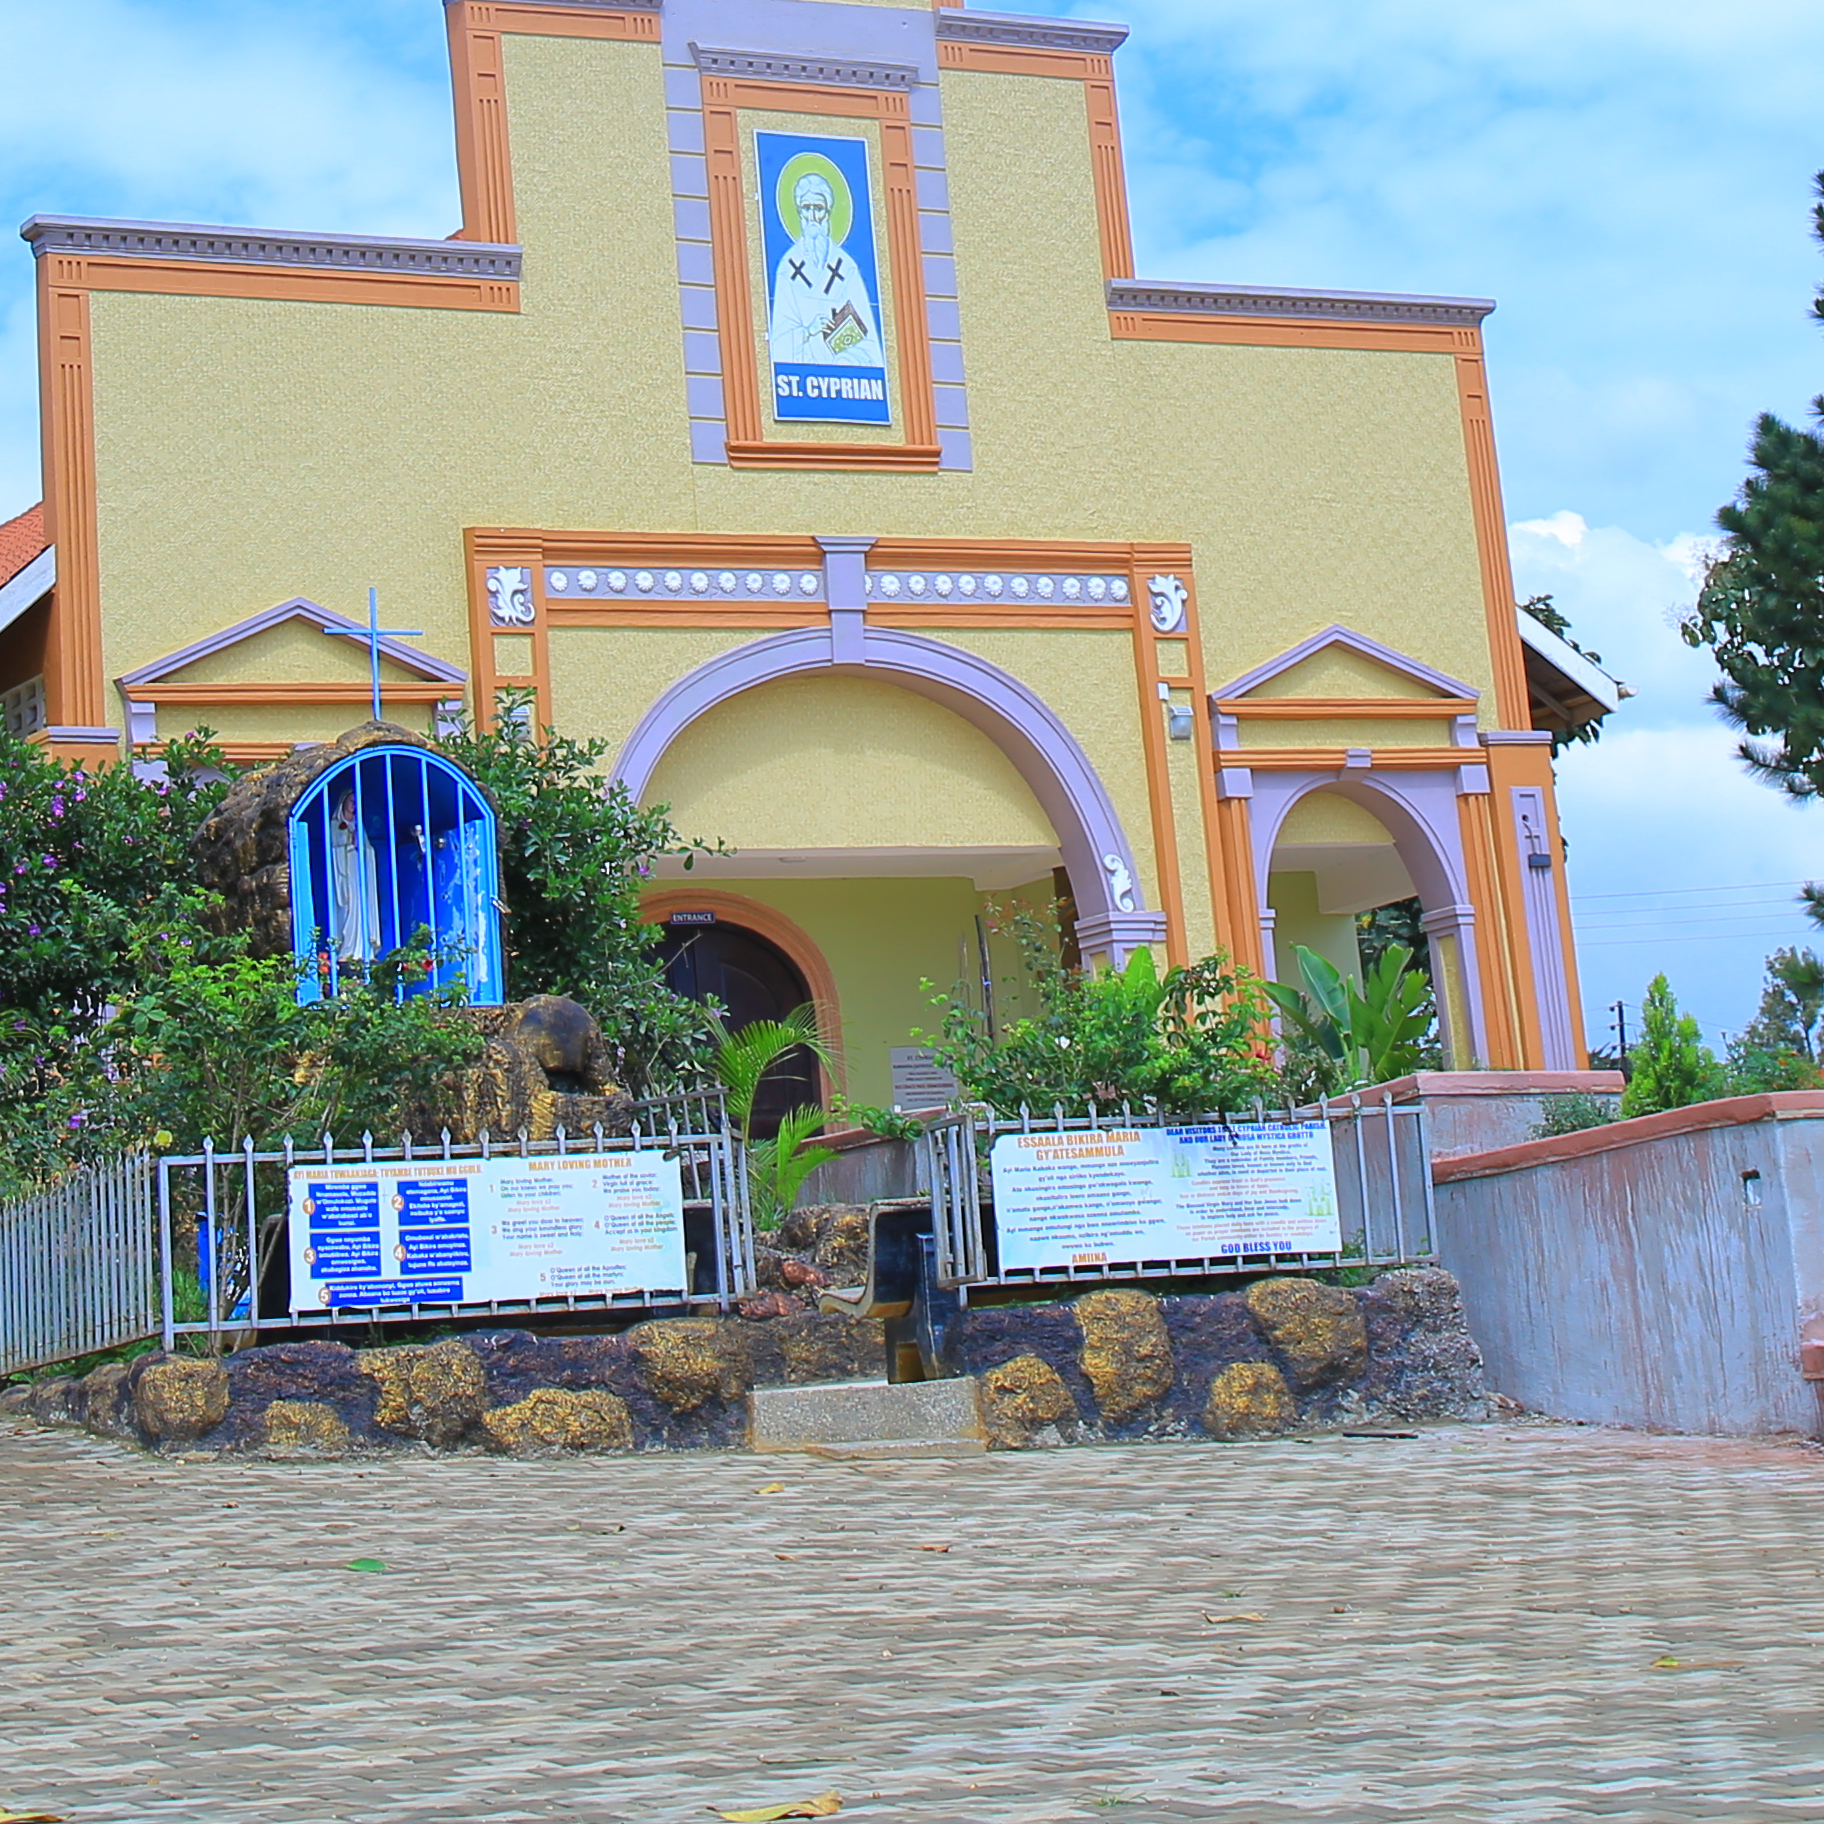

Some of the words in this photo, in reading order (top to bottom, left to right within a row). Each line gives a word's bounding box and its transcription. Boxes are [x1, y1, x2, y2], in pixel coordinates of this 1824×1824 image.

[777, 374, 804, 397] ST.
[806, 376, 884, 400] CYPRIAN
[672, 913, 712, 922] ENTRANCE
[1185, 1126, 1216, 1135] VISITORS
[1238, 1124, 1266, 1132] CYPRIAN
[1018, 1135, 1063, 1148] ESSAALA
[1066, 1133, 1103, 1145] BIKIRA
[1105, 1130, 1140, 1143] MARIA
[1179, 1136, 1193, 1144] AND
[1210, 1135, 1226, 1143] LADY
[1257, 1132, 1286, 1140] MYSTICA
[1287, 1131, 1313, 1139] GROTTO
[1036, 1145, 1124, 1160] GY'ATESAMMULA
[528, 1161, 556, 1171] MARY
[558, 1159, 591, 1170] LOVING
[593, 1158, 632, 1168] MOTHER
[305, 1169, 328, 1179] MARIA
[500, 1178, 514, 1186] Mary
[592, 1179, 598, 1188] 2
[489, 1184, 494, 1193] 1
[305, 1200, 312, 1212] 1
[393, 1196, 402, 1208] 2
[491, 1225, 497, 1234] 3
[594, 1220, 600, 1229] 4
[394, 1247, 403, 1259] 4
[1221, 1243, 1240, 1253] GOD
[1242, 1242, 1271, 1252] BLESS
[1273, 1241, 1292, 1251] YOU
[305, 1250, 315, 1262] 3
[1072, 1252, 1108, 1264] AMIINA
[540, 1273, 546, 1282] 5
[320, 1290, 329, 1302] 5
